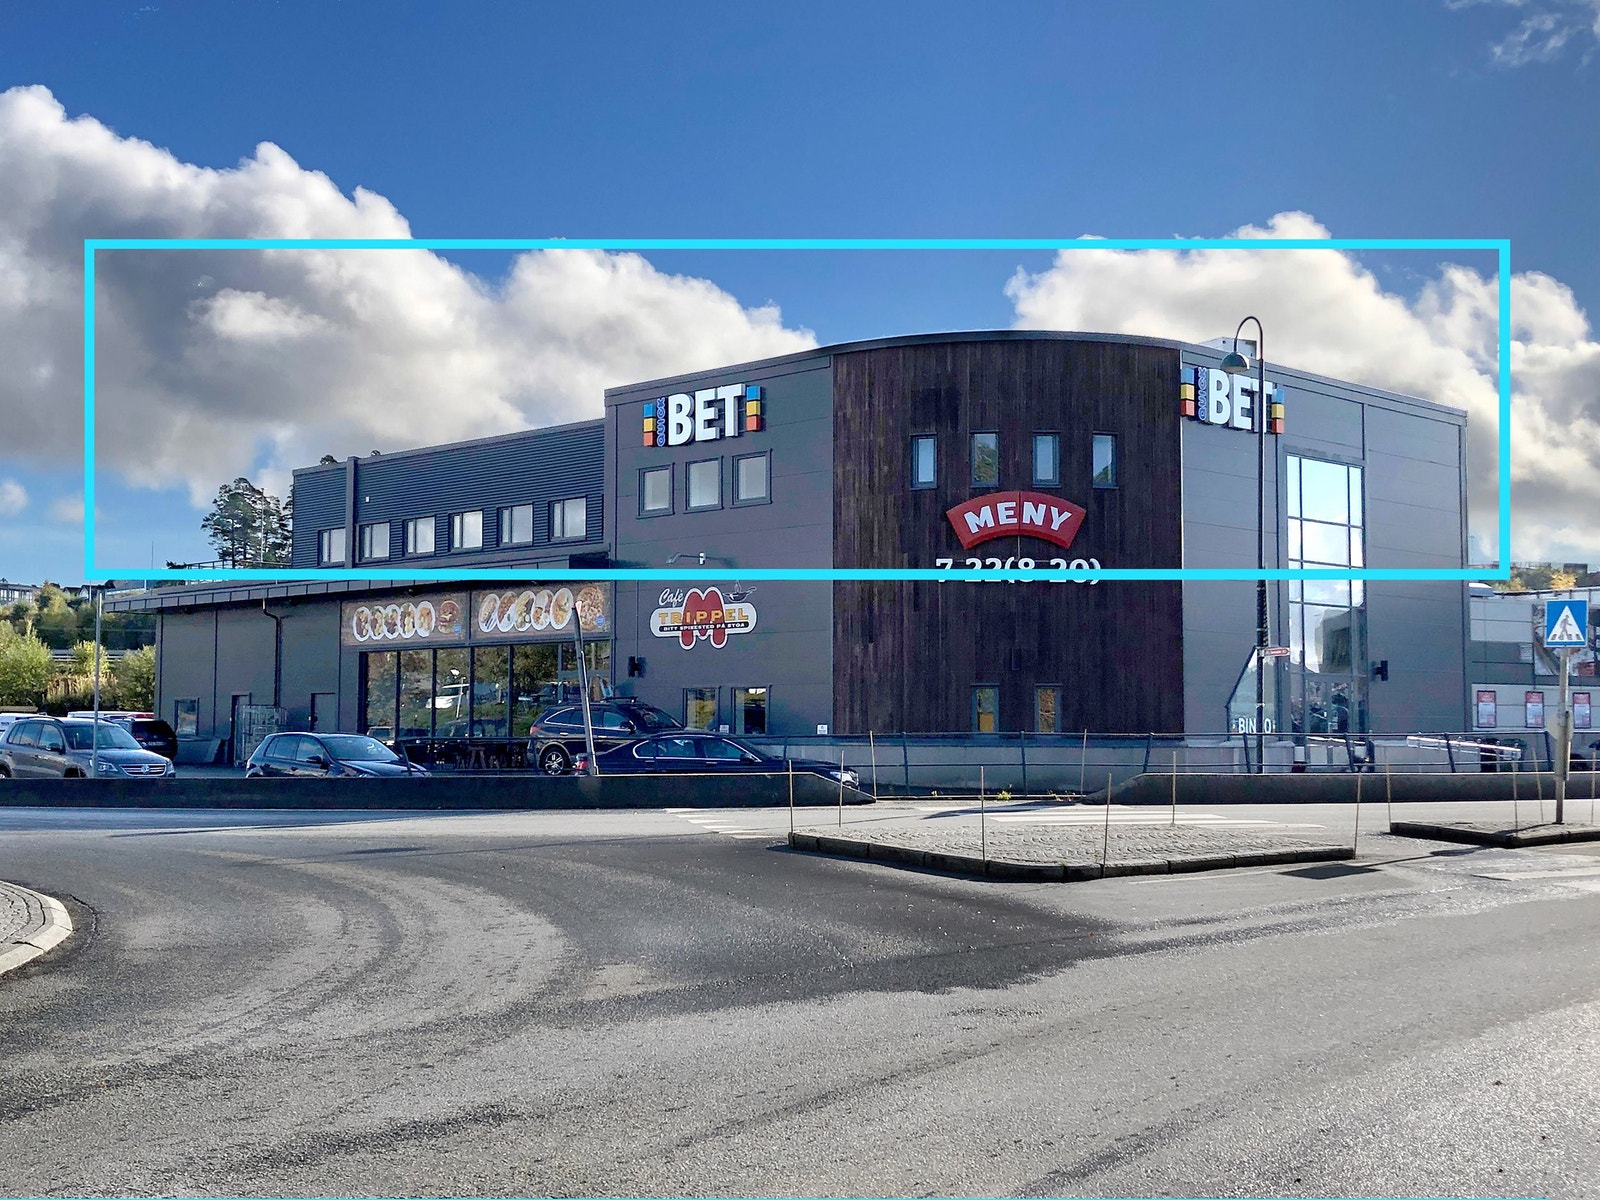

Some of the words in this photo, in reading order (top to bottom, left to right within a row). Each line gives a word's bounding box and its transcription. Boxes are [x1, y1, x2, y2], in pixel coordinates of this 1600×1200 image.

[1198, 367, 1207, 420] QUICK
[1208, 368, 1273, 433] BET
[656, 397, 666, 447] QUICK
[668, 383, 746, 446] BET
[963, 501, 1073, 534] MENY
[935, 556, 1102, 586] 722(820)
[658, 608, 749, 624] TRIPPEL
[1238, 718, 1272, 734] BINO
